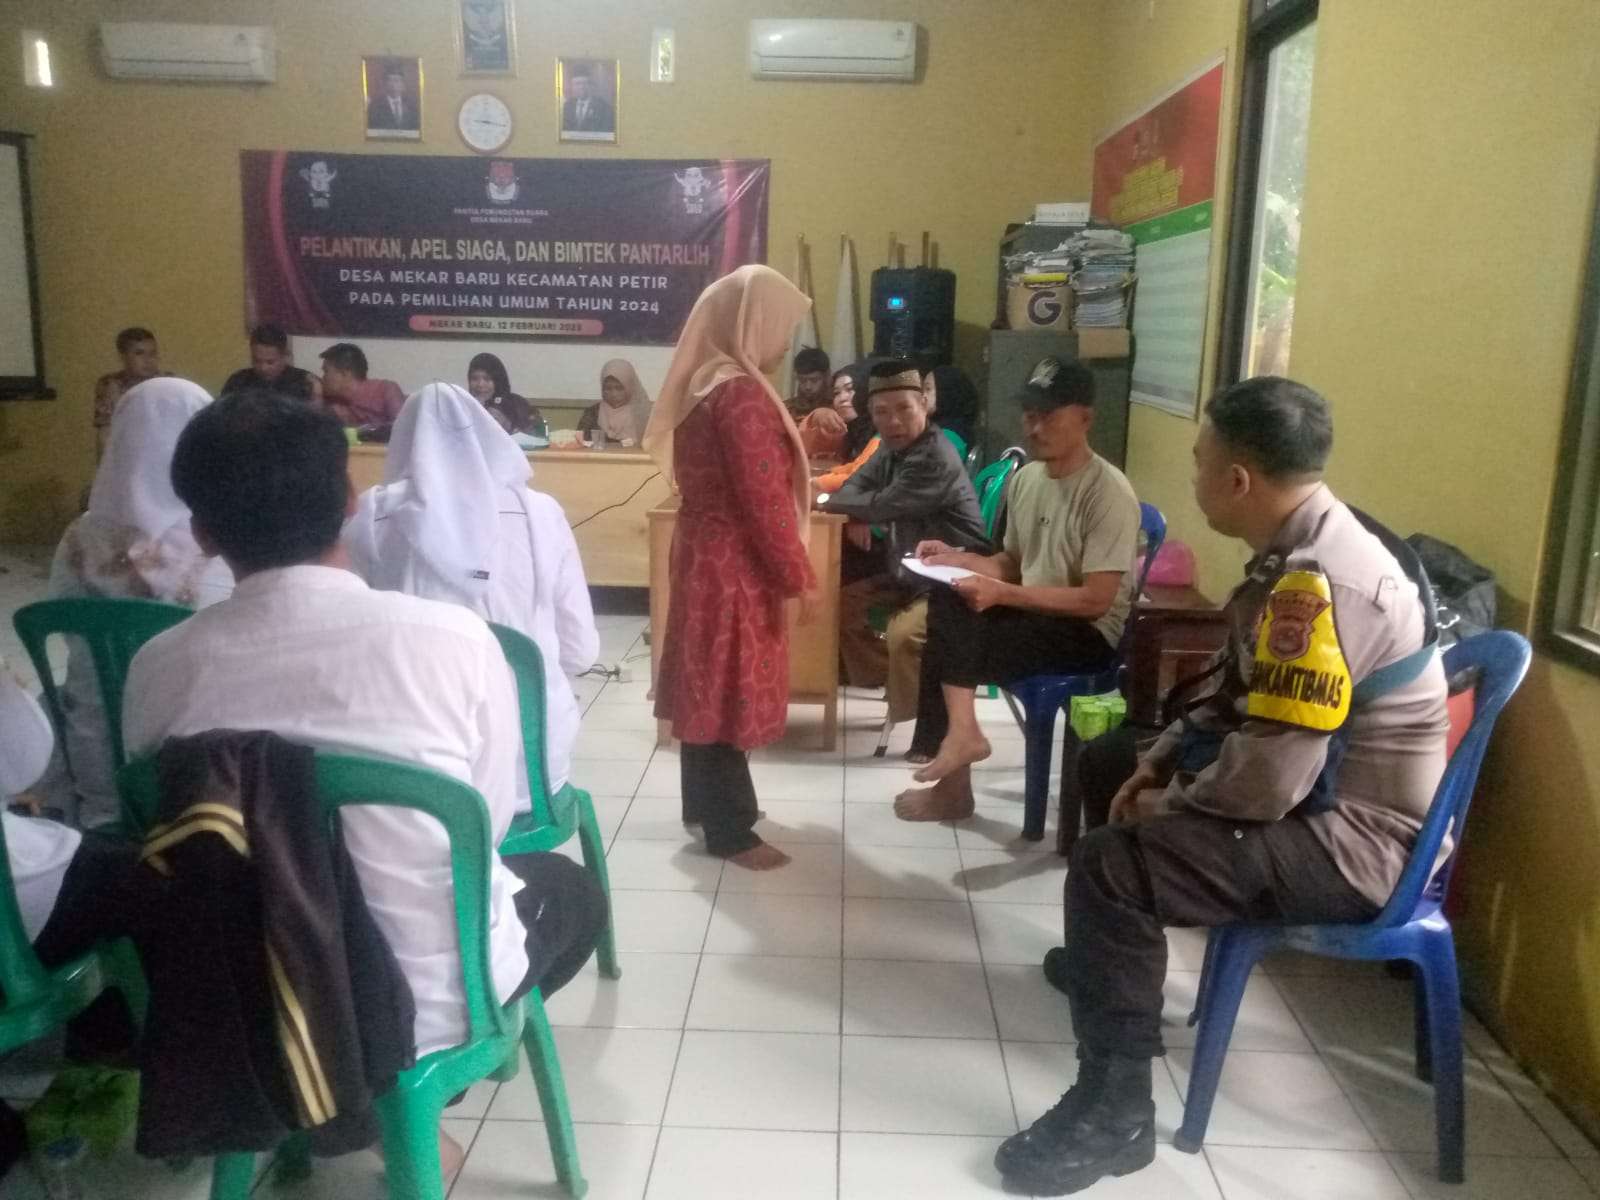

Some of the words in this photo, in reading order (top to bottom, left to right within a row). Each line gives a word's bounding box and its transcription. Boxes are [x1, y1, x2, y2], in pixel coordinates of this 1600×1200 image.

[300, 237, 406, 261] PELANTIKAN,
[410, 238, 453, 260] APEL
[456, 240, 511, 264] SIAGA,
[515, 241, 550, 263] DAN
[554, 242, 616, 264] BIMTEK
[619, 243, 710, 265] PANTARLIH
[339, 269, 385, 283] DESA
[390, 270, 449, 284] MEKAR
[455, 272, 500, 285] BARU
[506, 273, 613, 288] KECAMATAN
[619, 275, 668, 289] PETIR
[349, 291, 395, 305] PADA
[401, 293, 493, 308] PEMILIHAN
[499, 296, 550, 309] UMUM
[556, 297, 613, 311] TAHUN
[619, 300, 660, 315] 2024
[498, 321, 508, 330] 12
[510, 321, 557, 331] FEBRUARI
